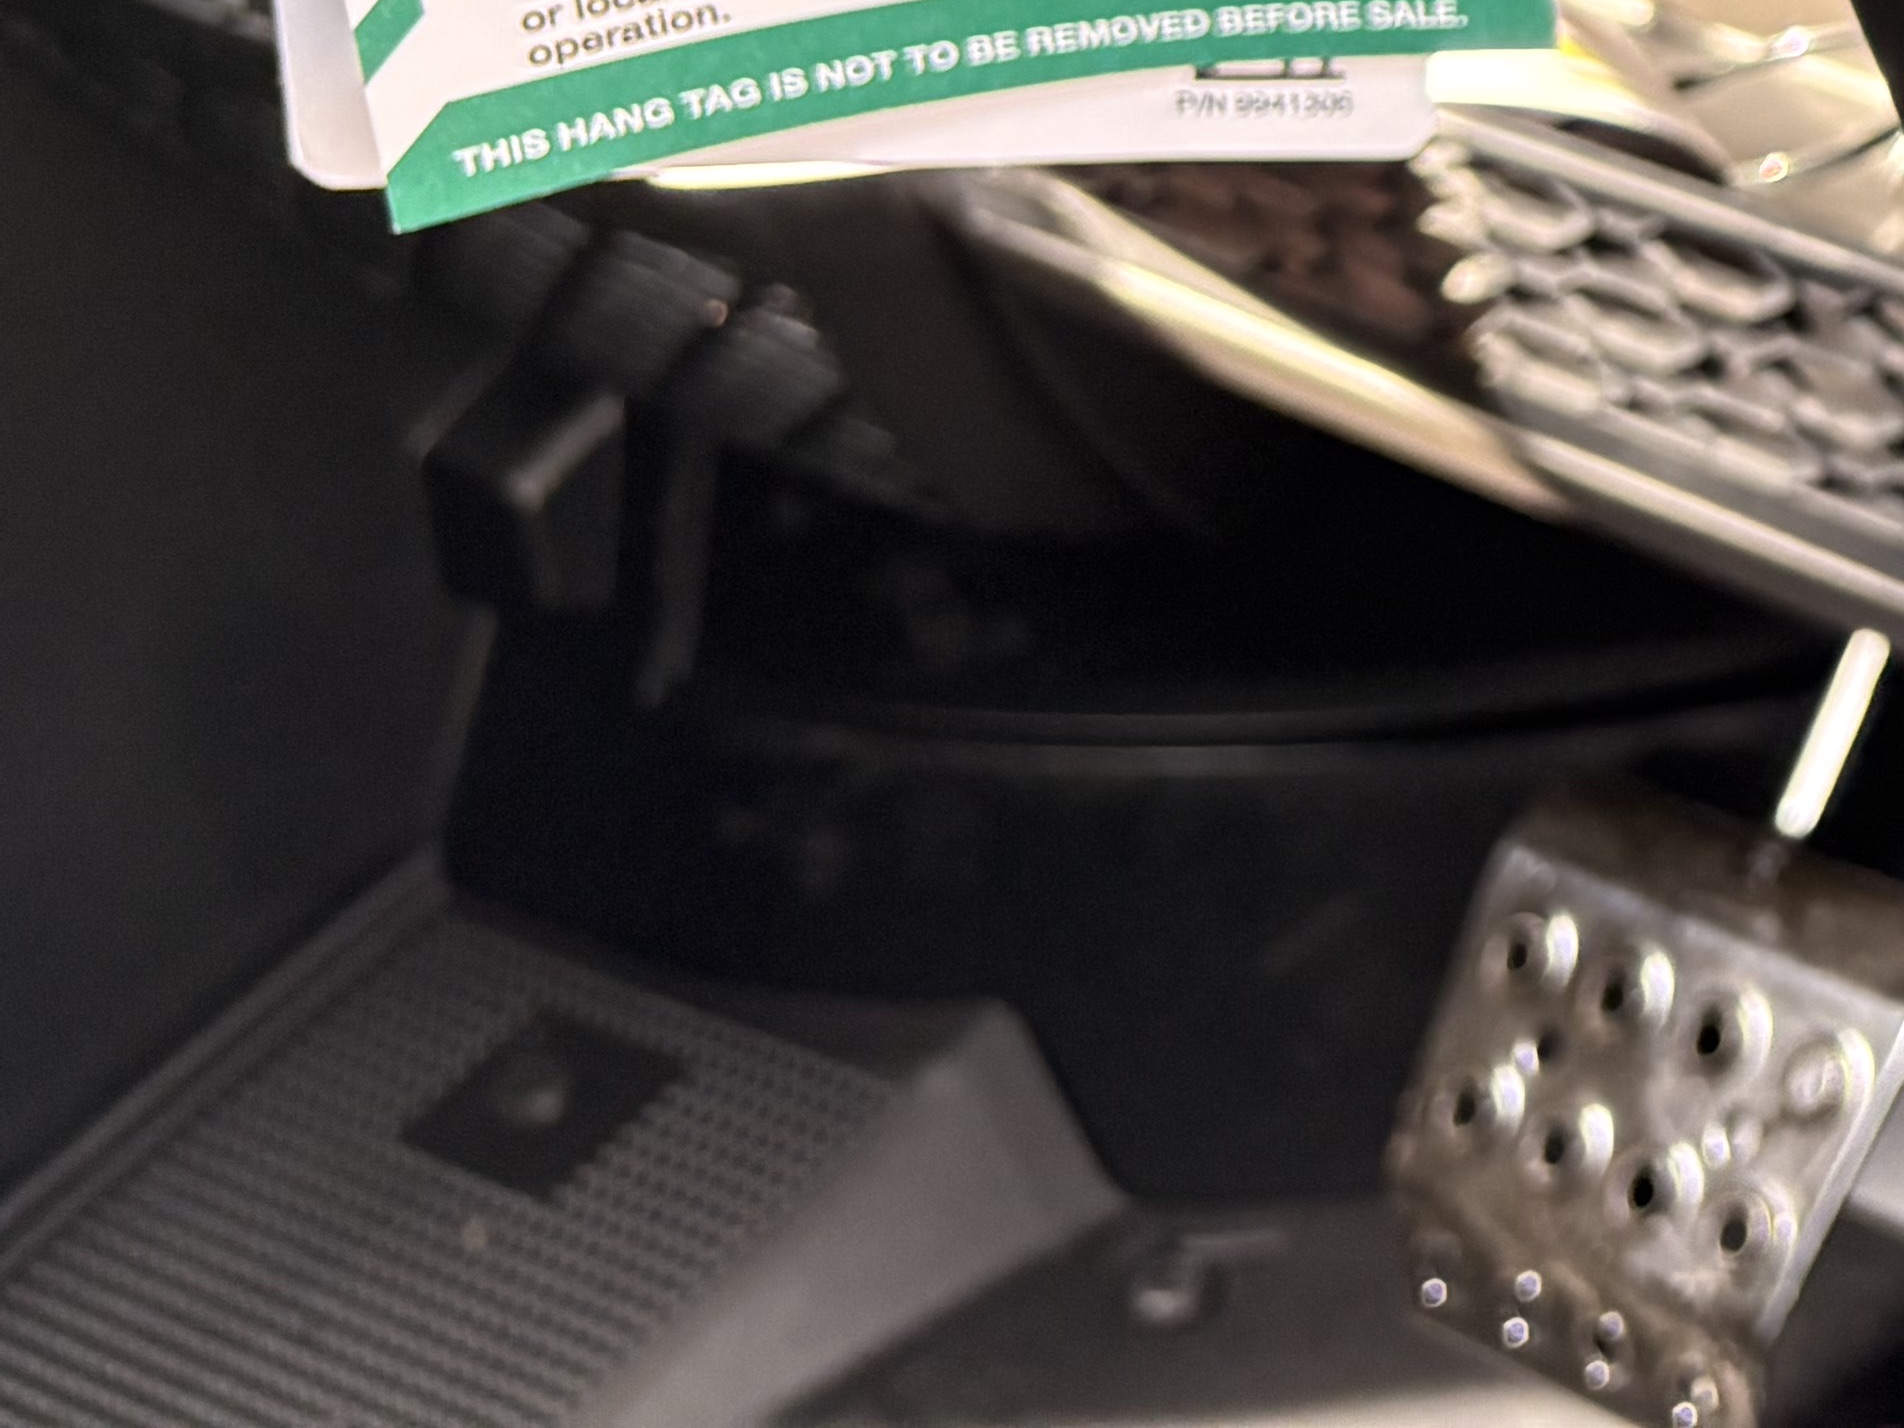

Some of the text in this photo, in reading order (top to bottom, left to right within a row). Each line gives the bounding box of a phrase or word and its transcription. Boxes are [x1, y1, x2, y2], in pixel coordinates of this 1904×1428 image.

[522, 3, 562, 35] or
[527, 0, 731, 66] operation.
[454, 128, 550, 178] THIS
[557, 97, 675, 151] HANG
[680, 78, 761, 121] TAG
[769, 67, 808, 102] IS
[815, 49, 897, 92] NOT
[902, 40, 959, 75] TO
[967, 30, 1021, 65] BE
[1025, 9, 1209, 60] REMOVED
[1214, 1, 1361, 38] BEFORE
[1175, 90, 1227, 115] P/N
